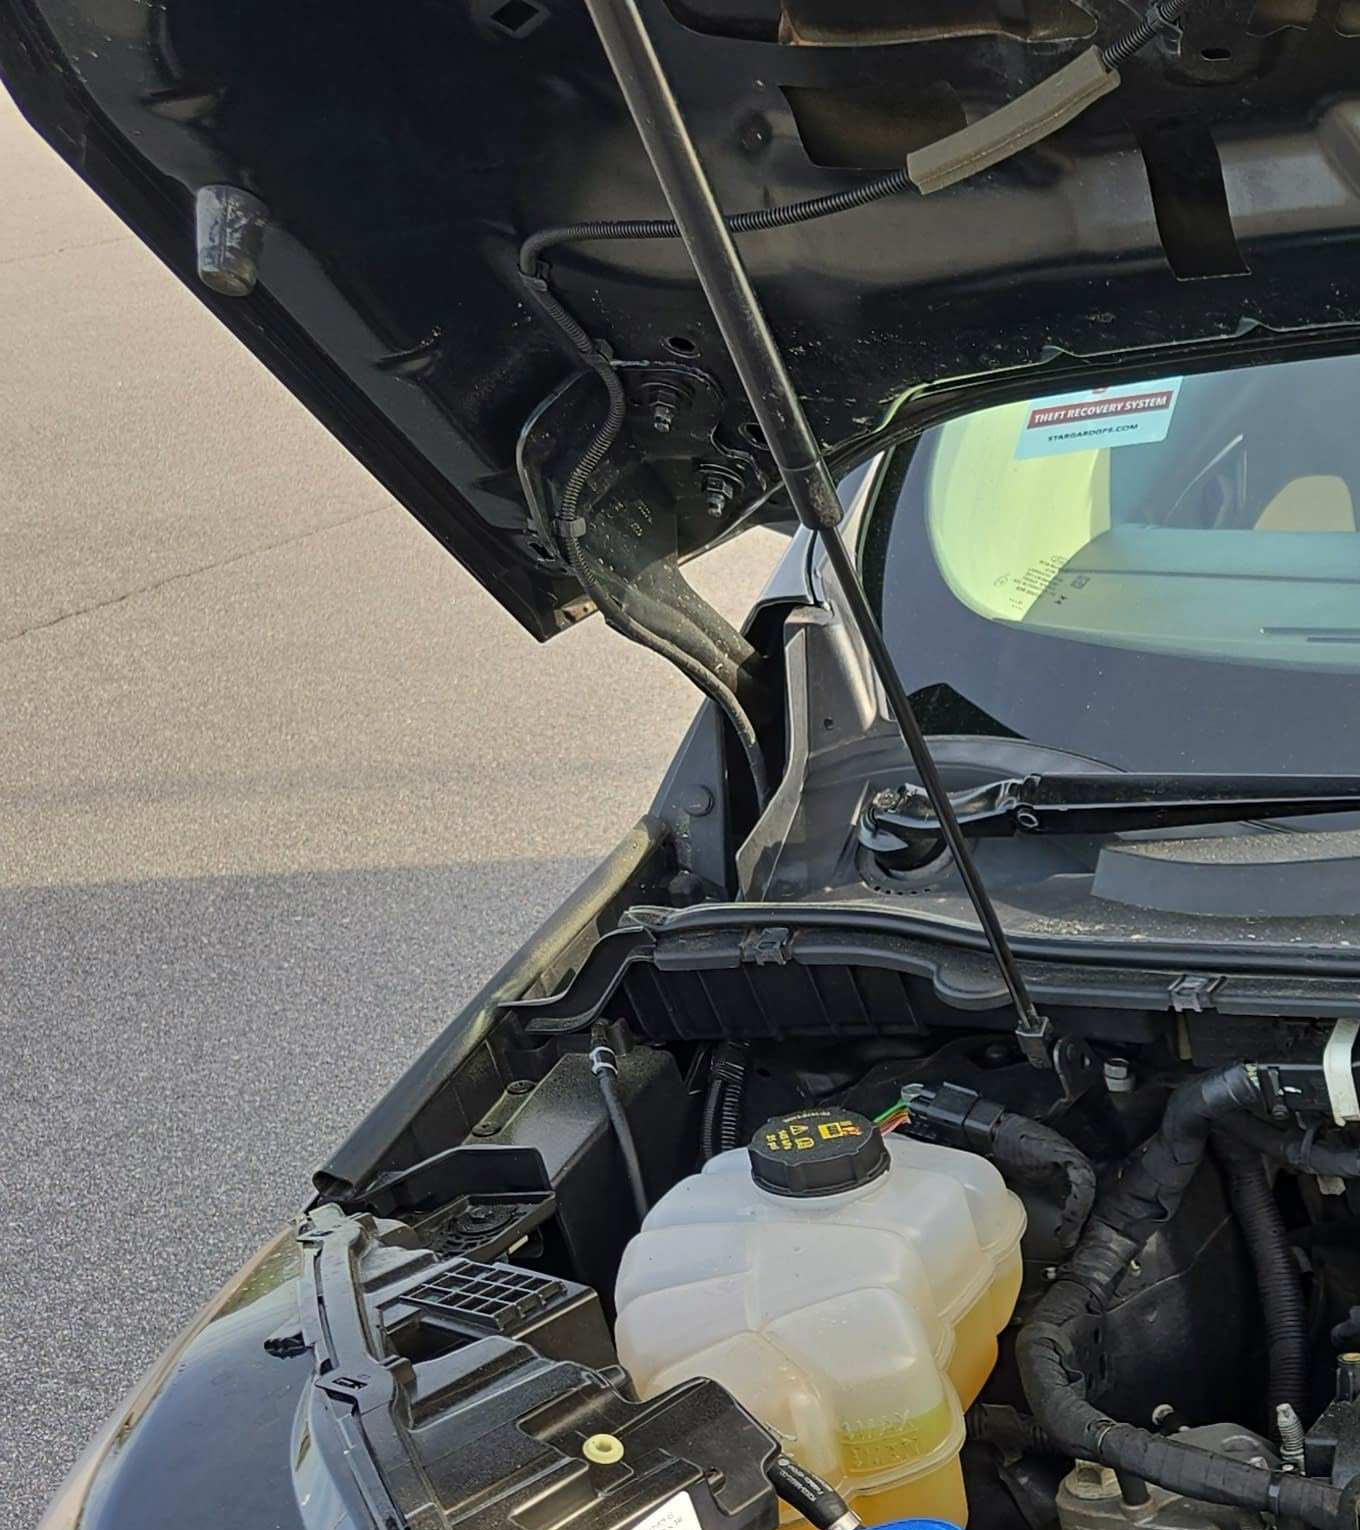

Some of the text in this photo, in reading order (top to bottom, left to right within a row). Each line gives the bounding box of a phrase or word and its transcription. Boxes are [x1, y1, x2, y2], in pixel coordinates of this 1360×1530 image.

[1034, 396, 1168, 424] THEFT RECOVERY SYSTEM
